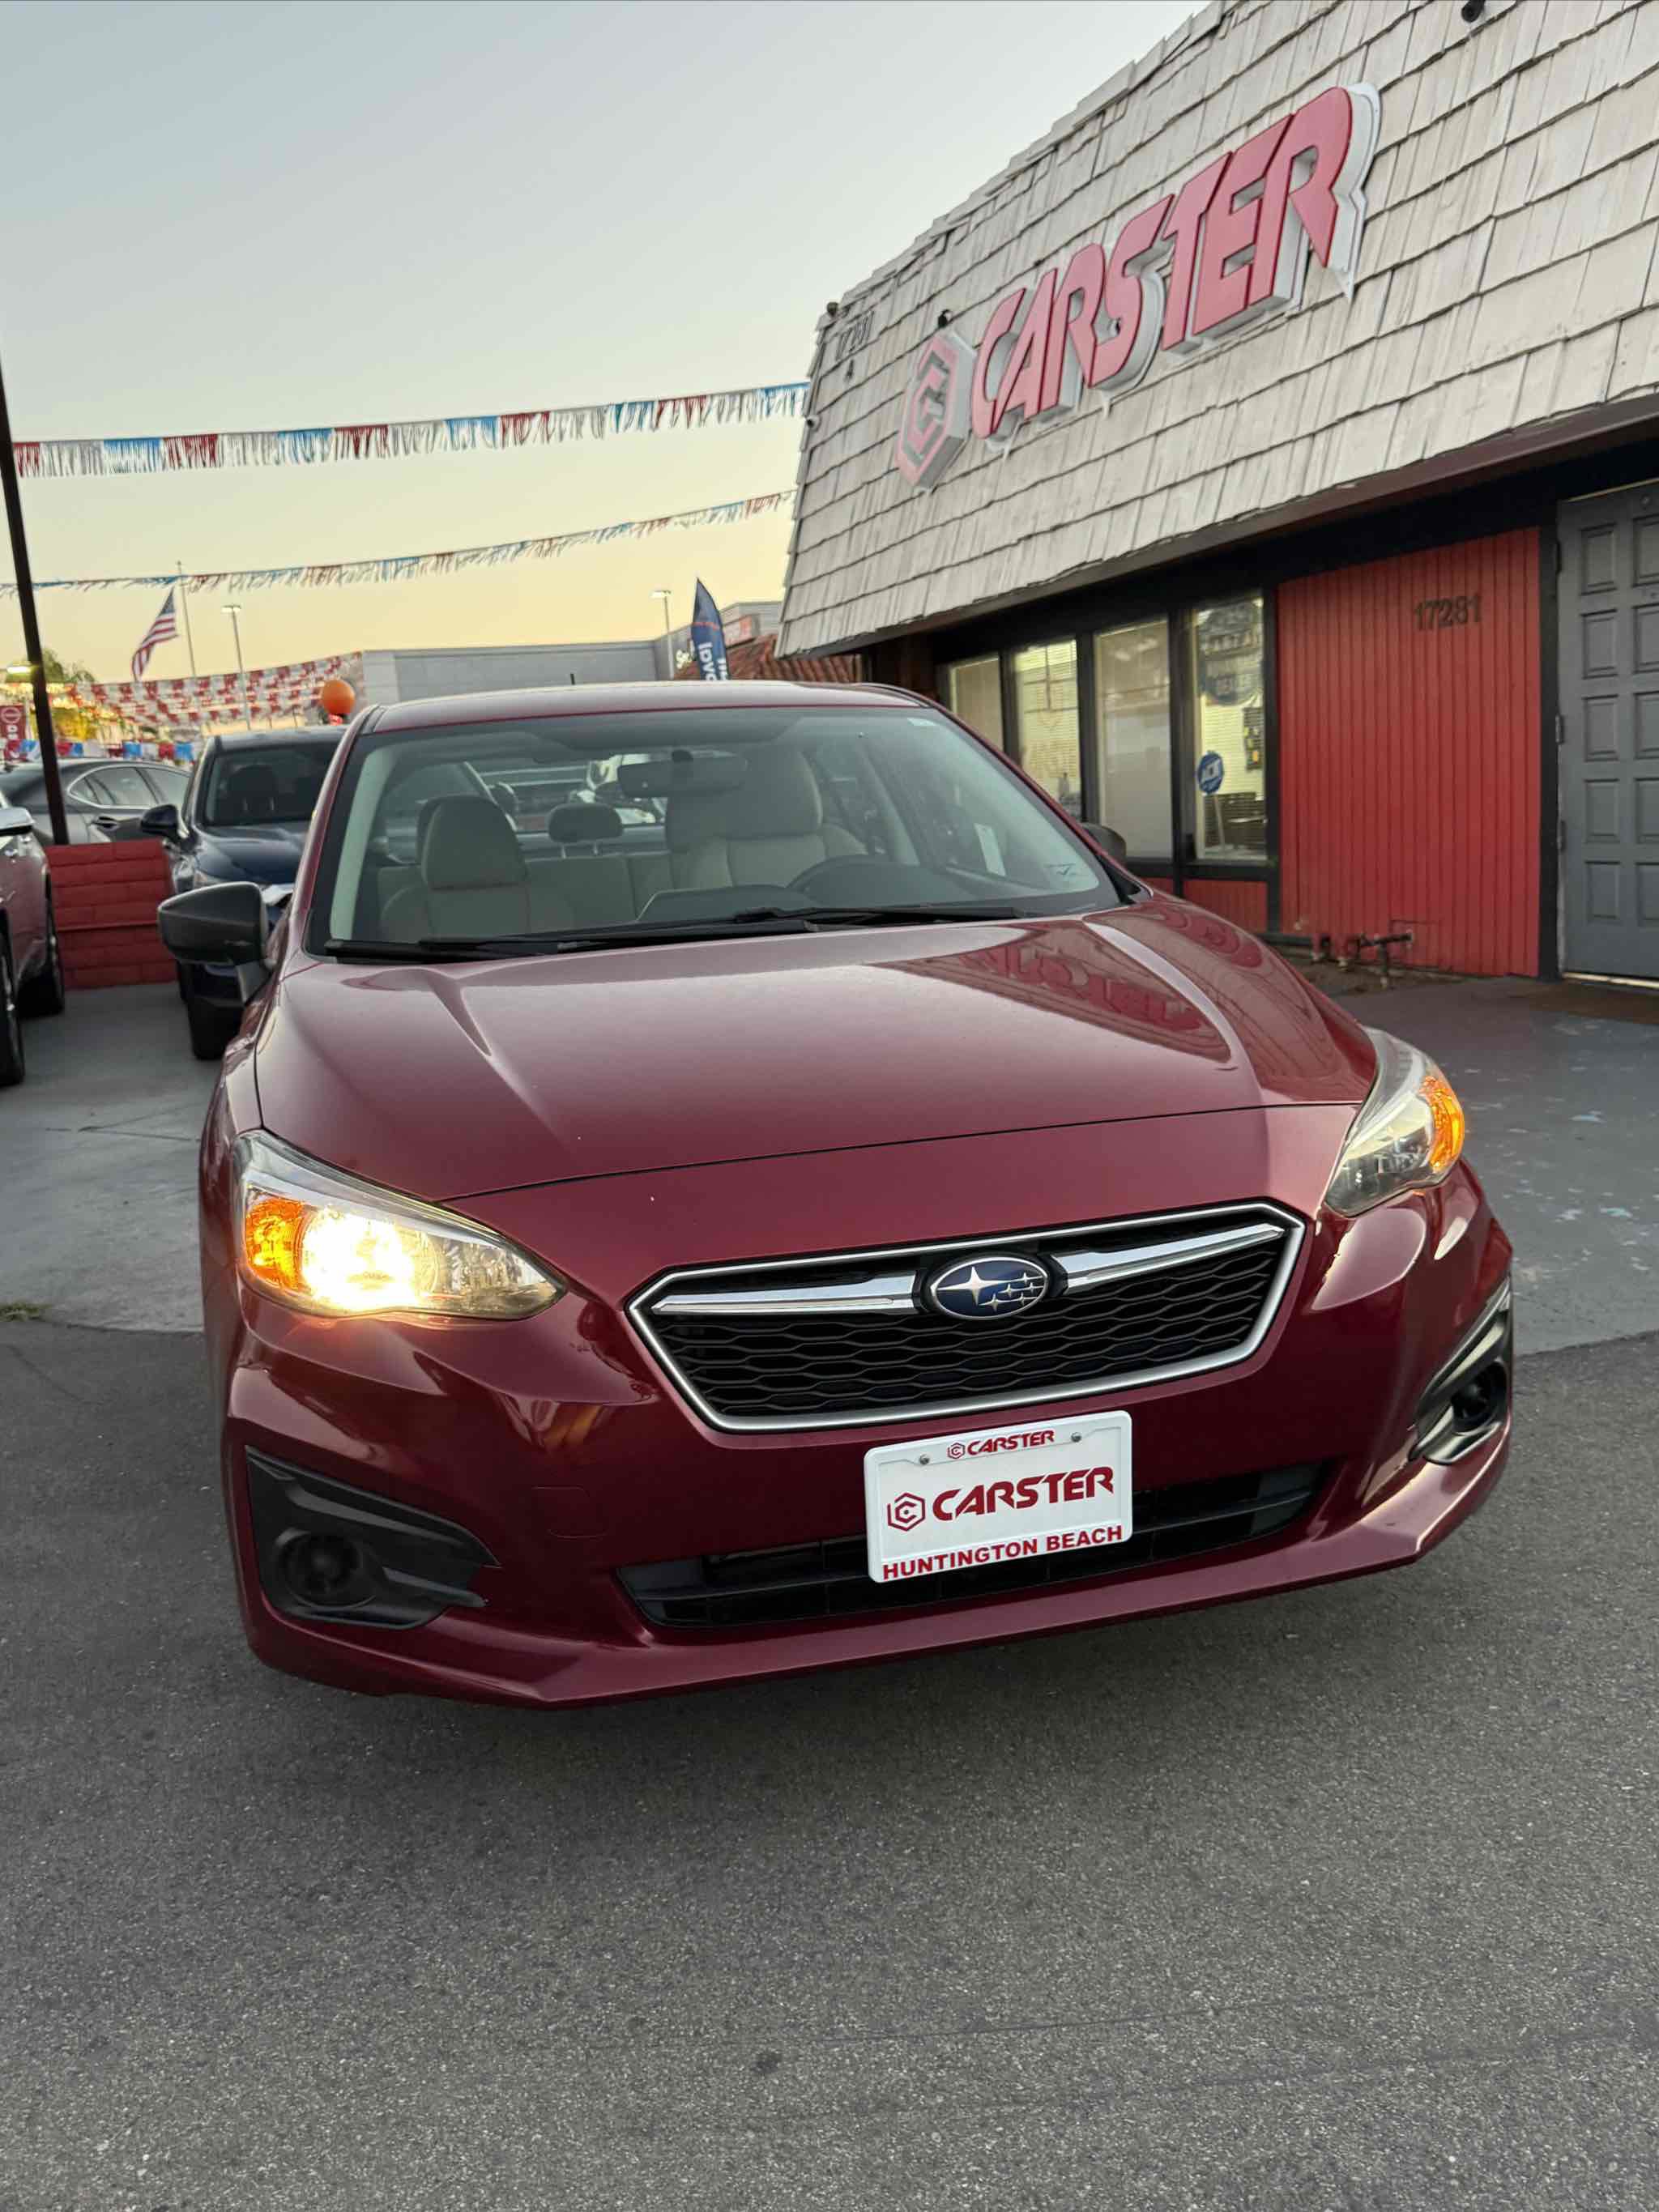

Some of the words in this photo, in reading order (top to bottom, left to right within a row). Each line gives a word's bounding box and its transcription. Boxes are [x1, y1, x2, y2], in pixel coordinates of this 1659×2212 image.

[972, 86, 1356, 441] CARSTER
[967, 1430, 1055, 1455] CARSTER
[932, 1466, 1115, 1521] CARSTER
[883, 1538, 1038, 1580] HUNTINGTON
[1046, 1525, 1123, 1552] BEACH
